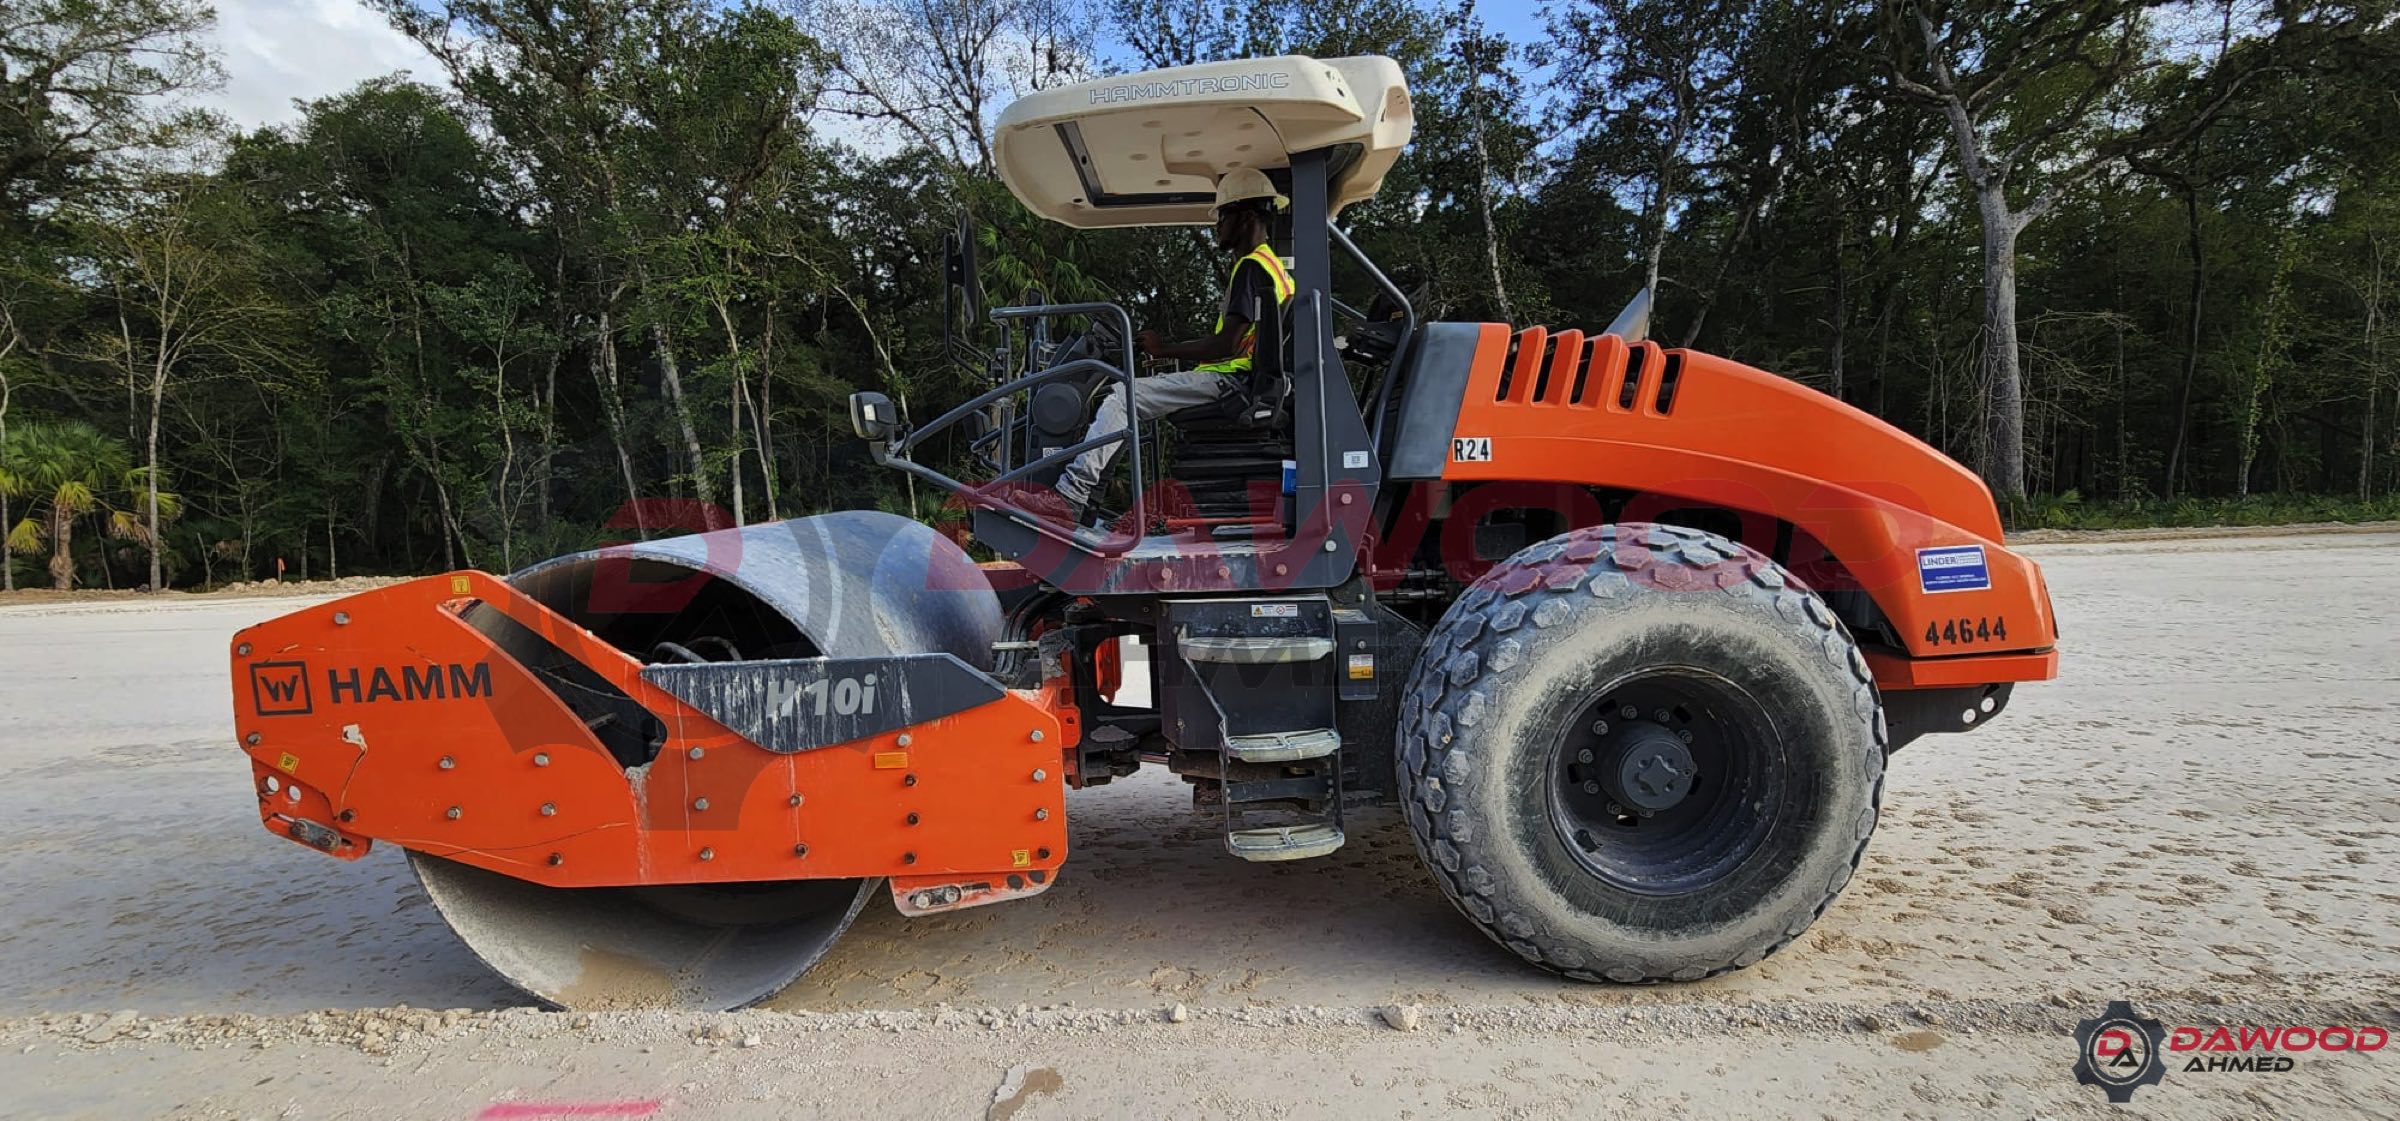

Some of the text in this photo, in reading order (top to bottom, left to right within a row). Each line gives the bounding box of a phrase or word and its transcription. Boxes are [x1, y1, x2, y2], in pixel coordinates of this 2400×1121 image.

[1089, 73, 1289, 104] HAMMTRONIC
[1454, 438, 1489, 461] R24
[1923, 556, 1957, 567] LINDER
[1925, 616, 2006, 646] 44644
[328, 662, 492, 703] HAMM
